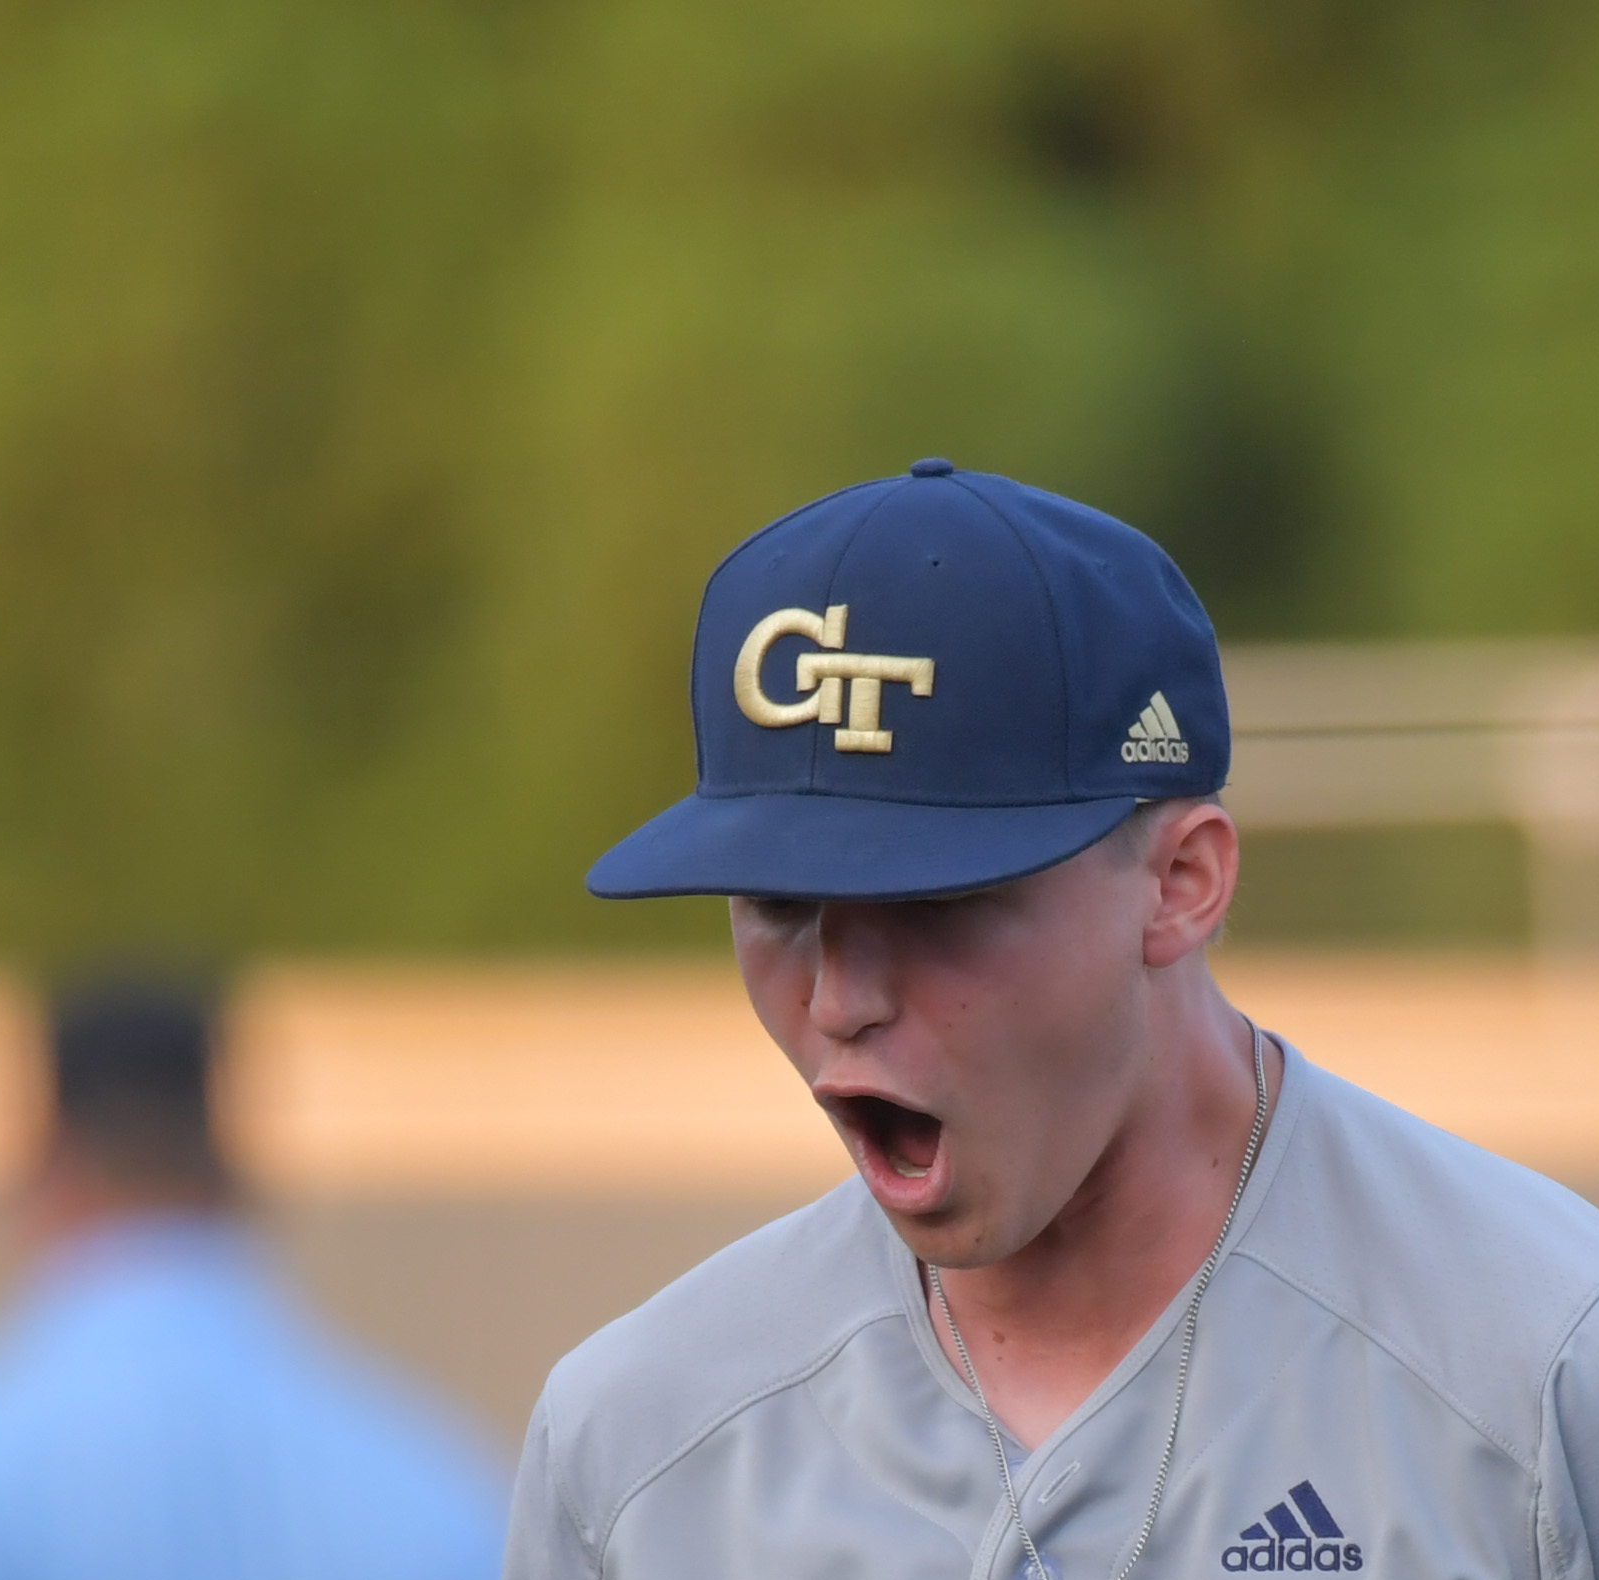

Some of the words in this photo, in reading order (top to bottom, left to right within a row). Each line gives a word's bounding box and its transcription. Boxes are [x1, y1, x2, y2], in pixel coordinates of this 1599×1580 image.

[733, 604, 935, 753] GT
[1120, 737, 1189, 764] adidas
[1221, 1537, 1363, 1572] adidas
